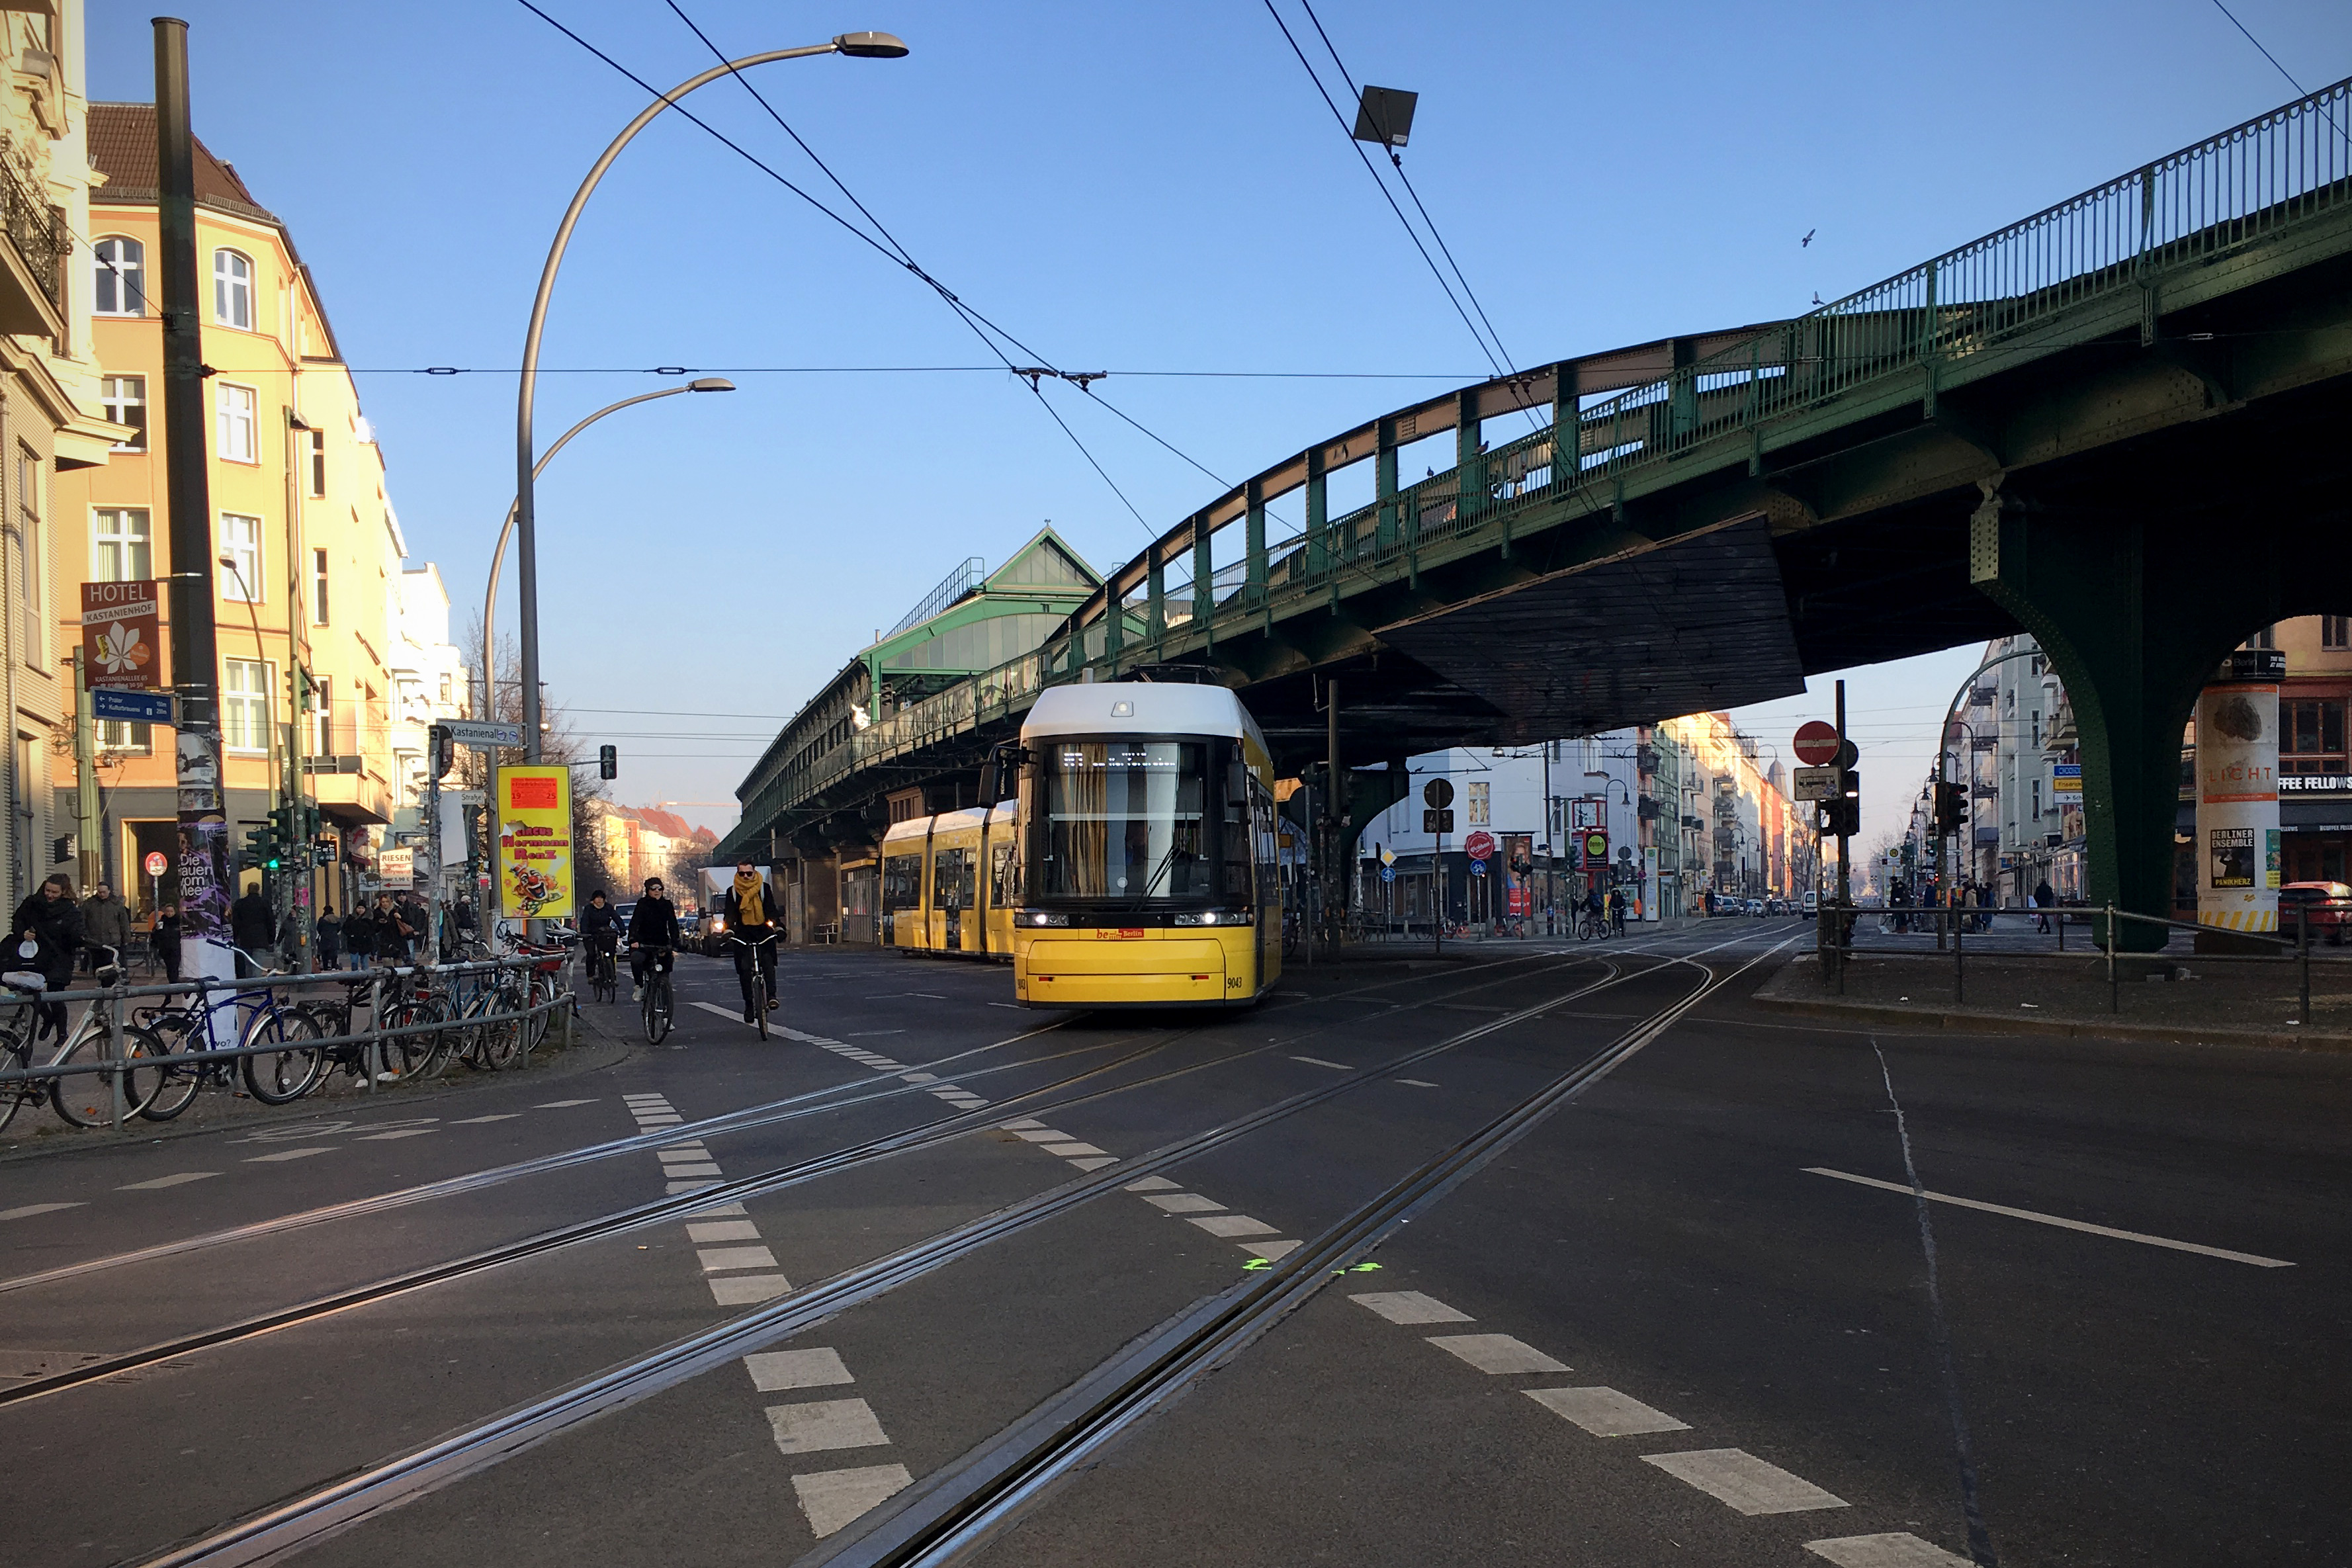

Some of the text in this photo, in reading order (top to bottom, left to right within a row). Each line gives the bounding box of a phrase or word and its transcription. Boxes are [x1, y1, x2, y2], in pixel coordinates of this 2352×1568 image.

[90, 584, 148, 602] HOTEL
[86, 603, 153, 622] KASTANIENHOF
[2209, 767, 2272, 782] LICHT
[2304, 776, 2352, 789] FELLOWS
[2212, 829, 2253, 840] BERLINER
[502, 835, 569, 848] Hermann
[2212, 838, 2253, 848] ENSEMBLE
[180, 853, 200, 866] Die
[514, 848, 557, 860] Renz
[2215, 877, 2251, 887] PANIKHERZ
[1097, 928, 1108, 939] be
[1227, 977, 1242, 989] 9043
